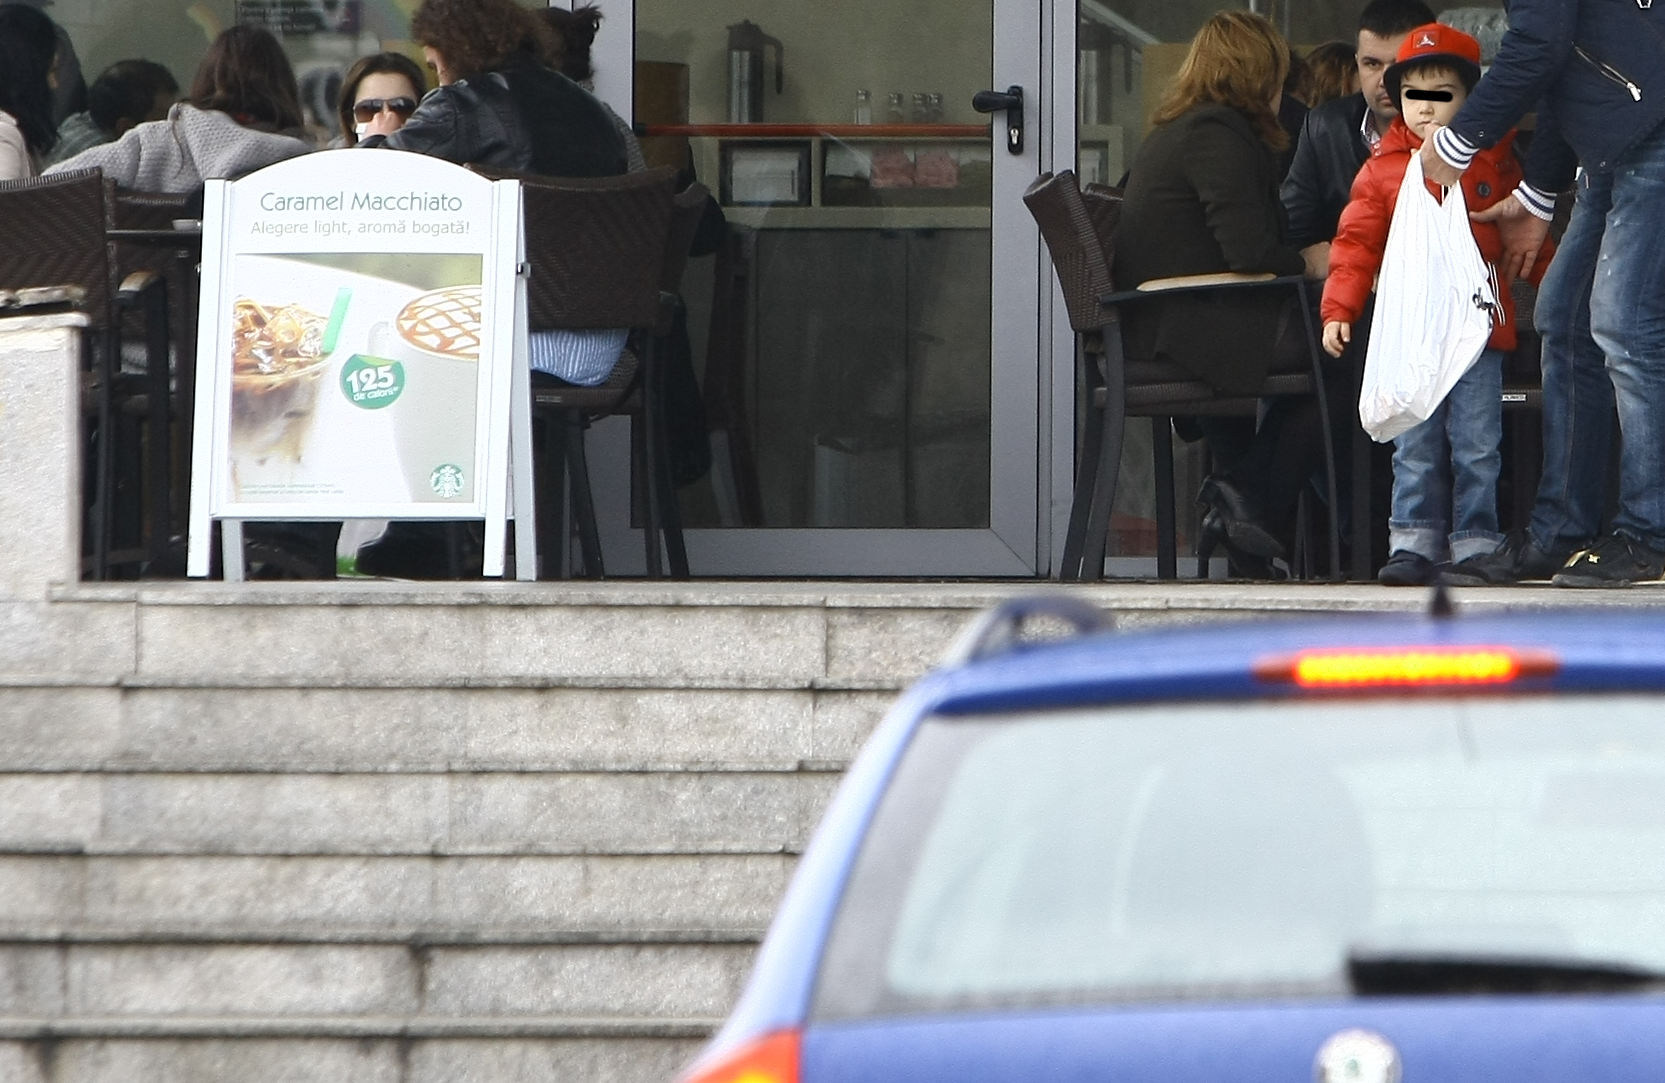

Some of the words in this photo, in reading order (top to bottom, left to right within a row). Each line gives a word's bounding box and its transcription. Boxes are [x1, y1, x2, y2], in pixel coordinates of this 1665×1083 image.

[260, 191, 344, 211] Caramel
[350, 191, 463, 211] Macchiato
[250, 221, 308, 237] Alegere
[314, 219, 352, 236] light,
[357, 219, 407, 235] aromă
[412, 219, 470, 237] bogată!
[346, 365, 394, 393] 125
